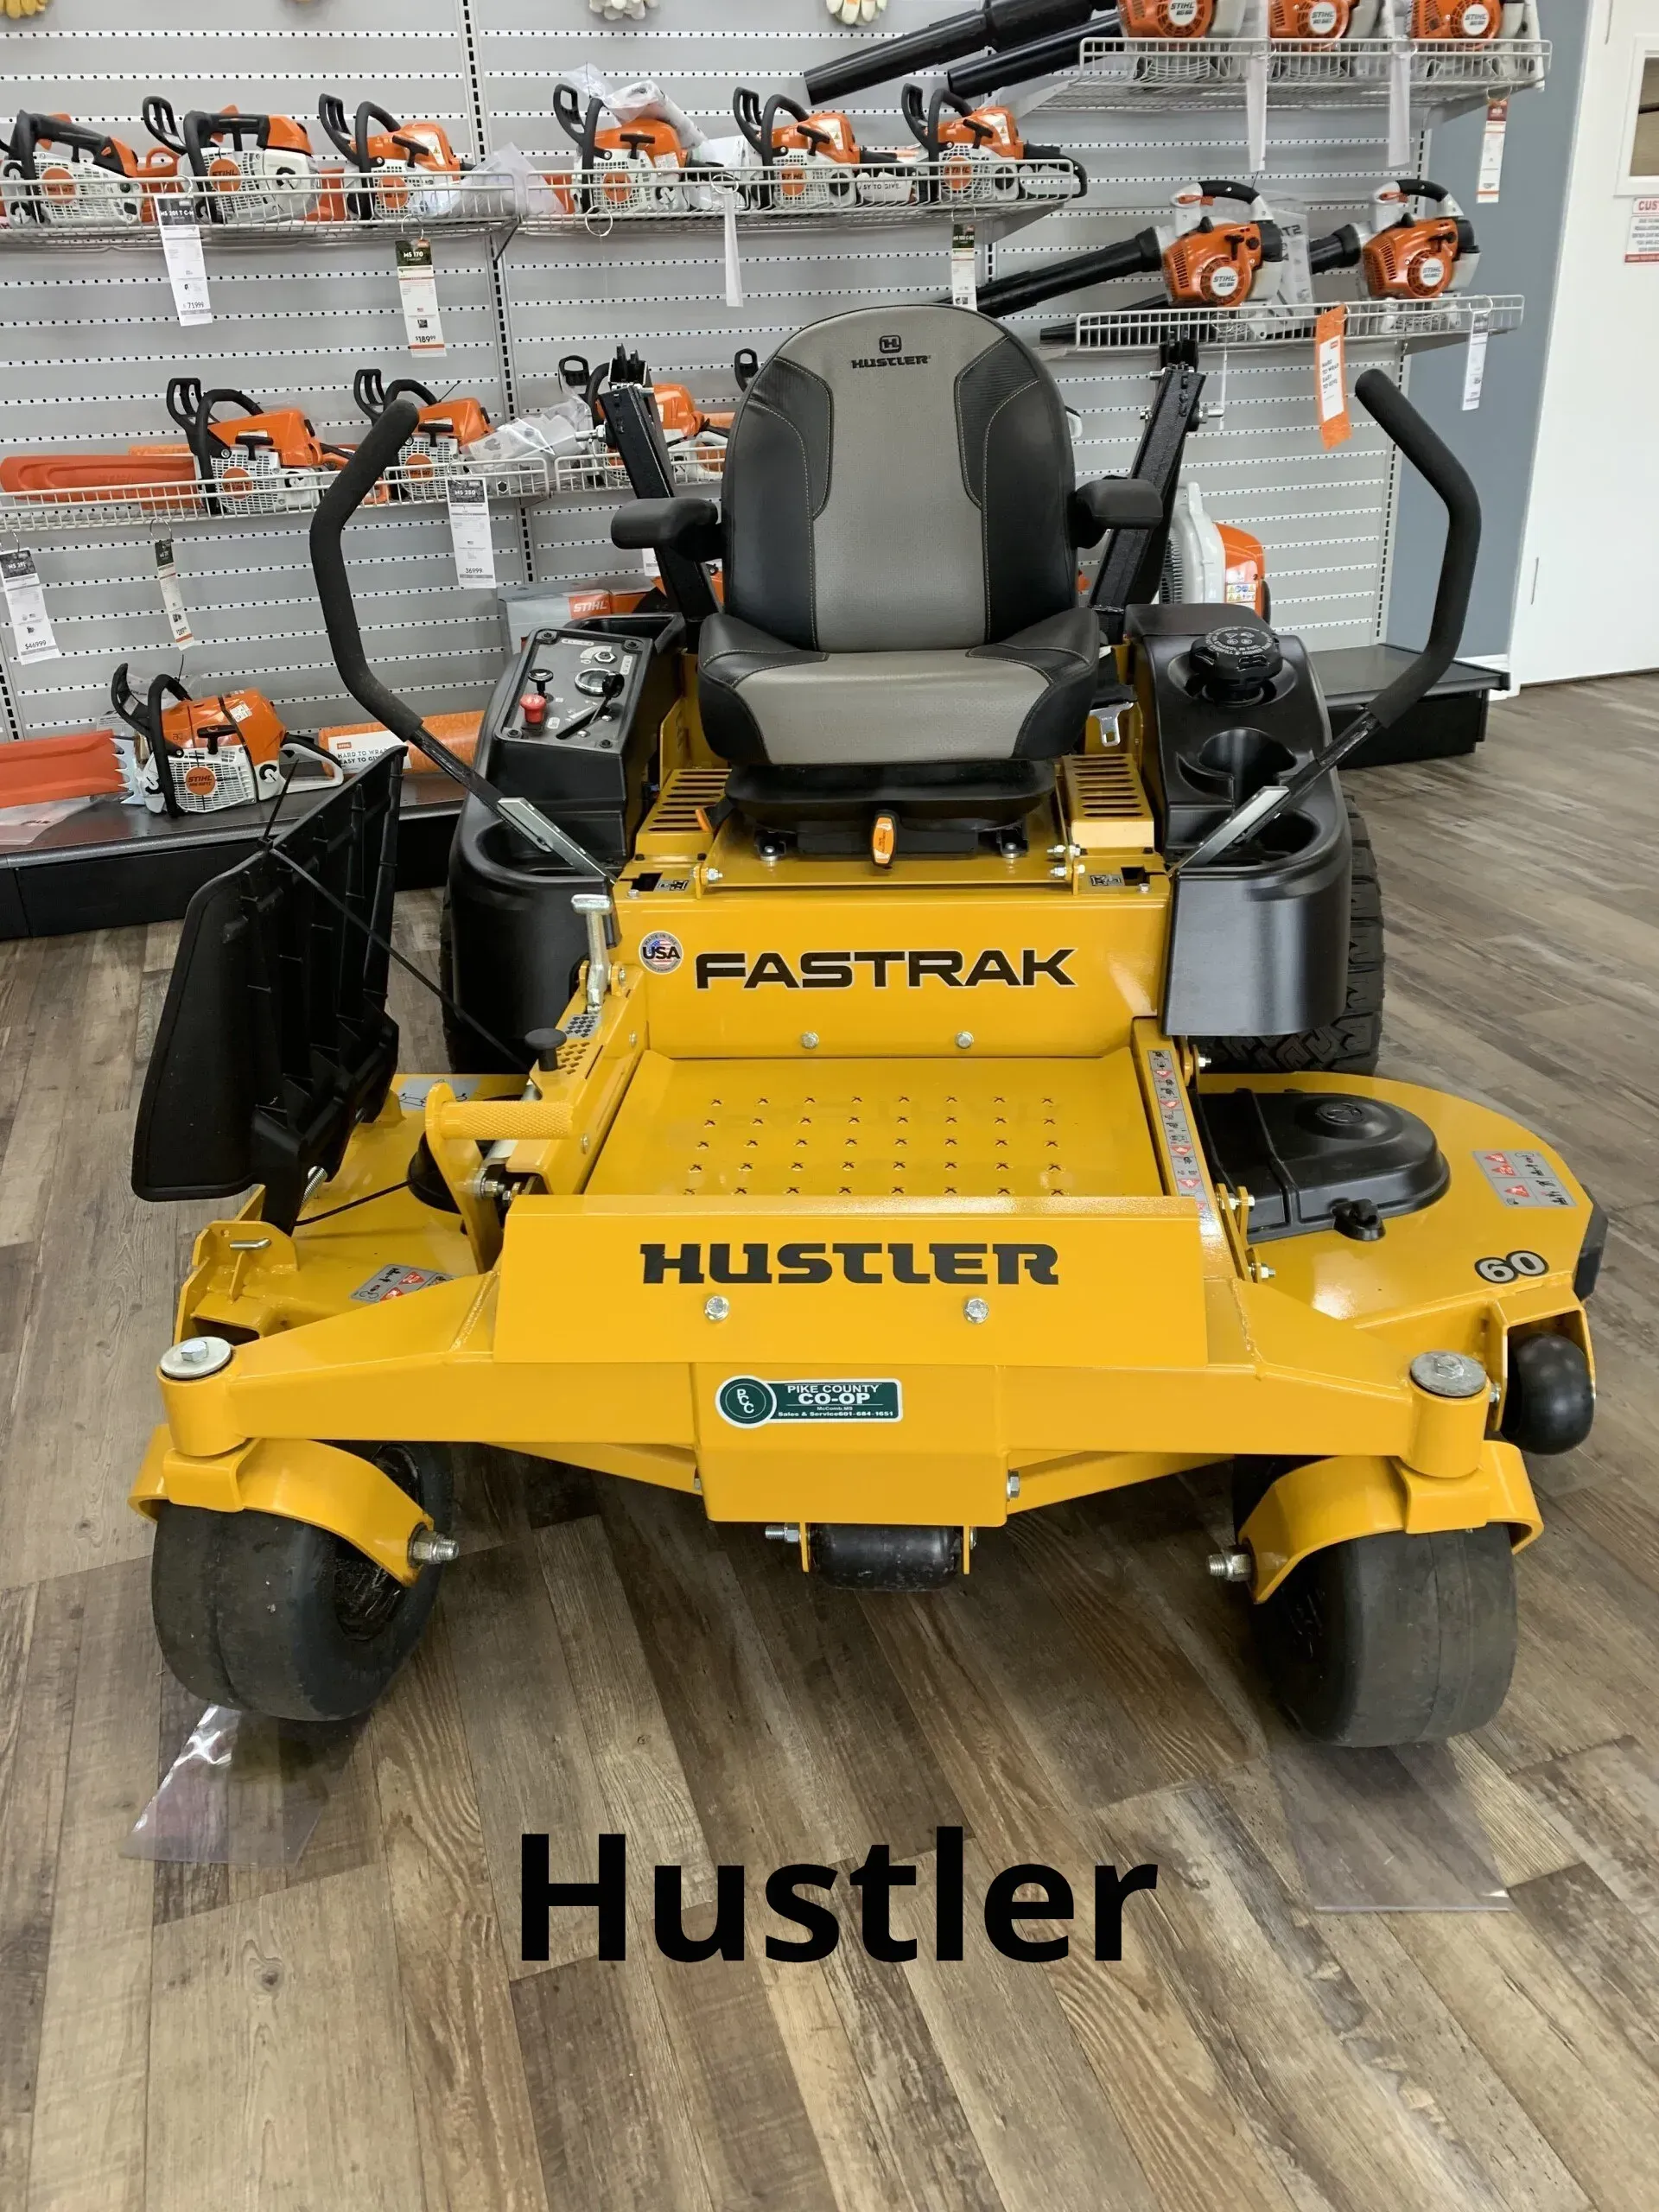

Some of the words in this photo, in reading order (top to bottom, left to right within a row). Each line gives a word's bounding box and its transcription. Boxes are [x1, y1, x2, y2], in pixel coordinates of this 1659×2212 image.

[1638, 200, 1659, 211] CUS
[851, 355, 929, 369] HUSTLER
[573, 600, 607, 613] STIHL
[642, 946, 681, 960] USA
[696, 949, 1077, 988] FASTRAK
[640, 1243, 1059, 1285] HUSTLER
[1474, 1249, 1549, 1284] 60
[822, 1384, 880, 1393] COUNTY
[798, 1392, 871, 1404] CO-OP
